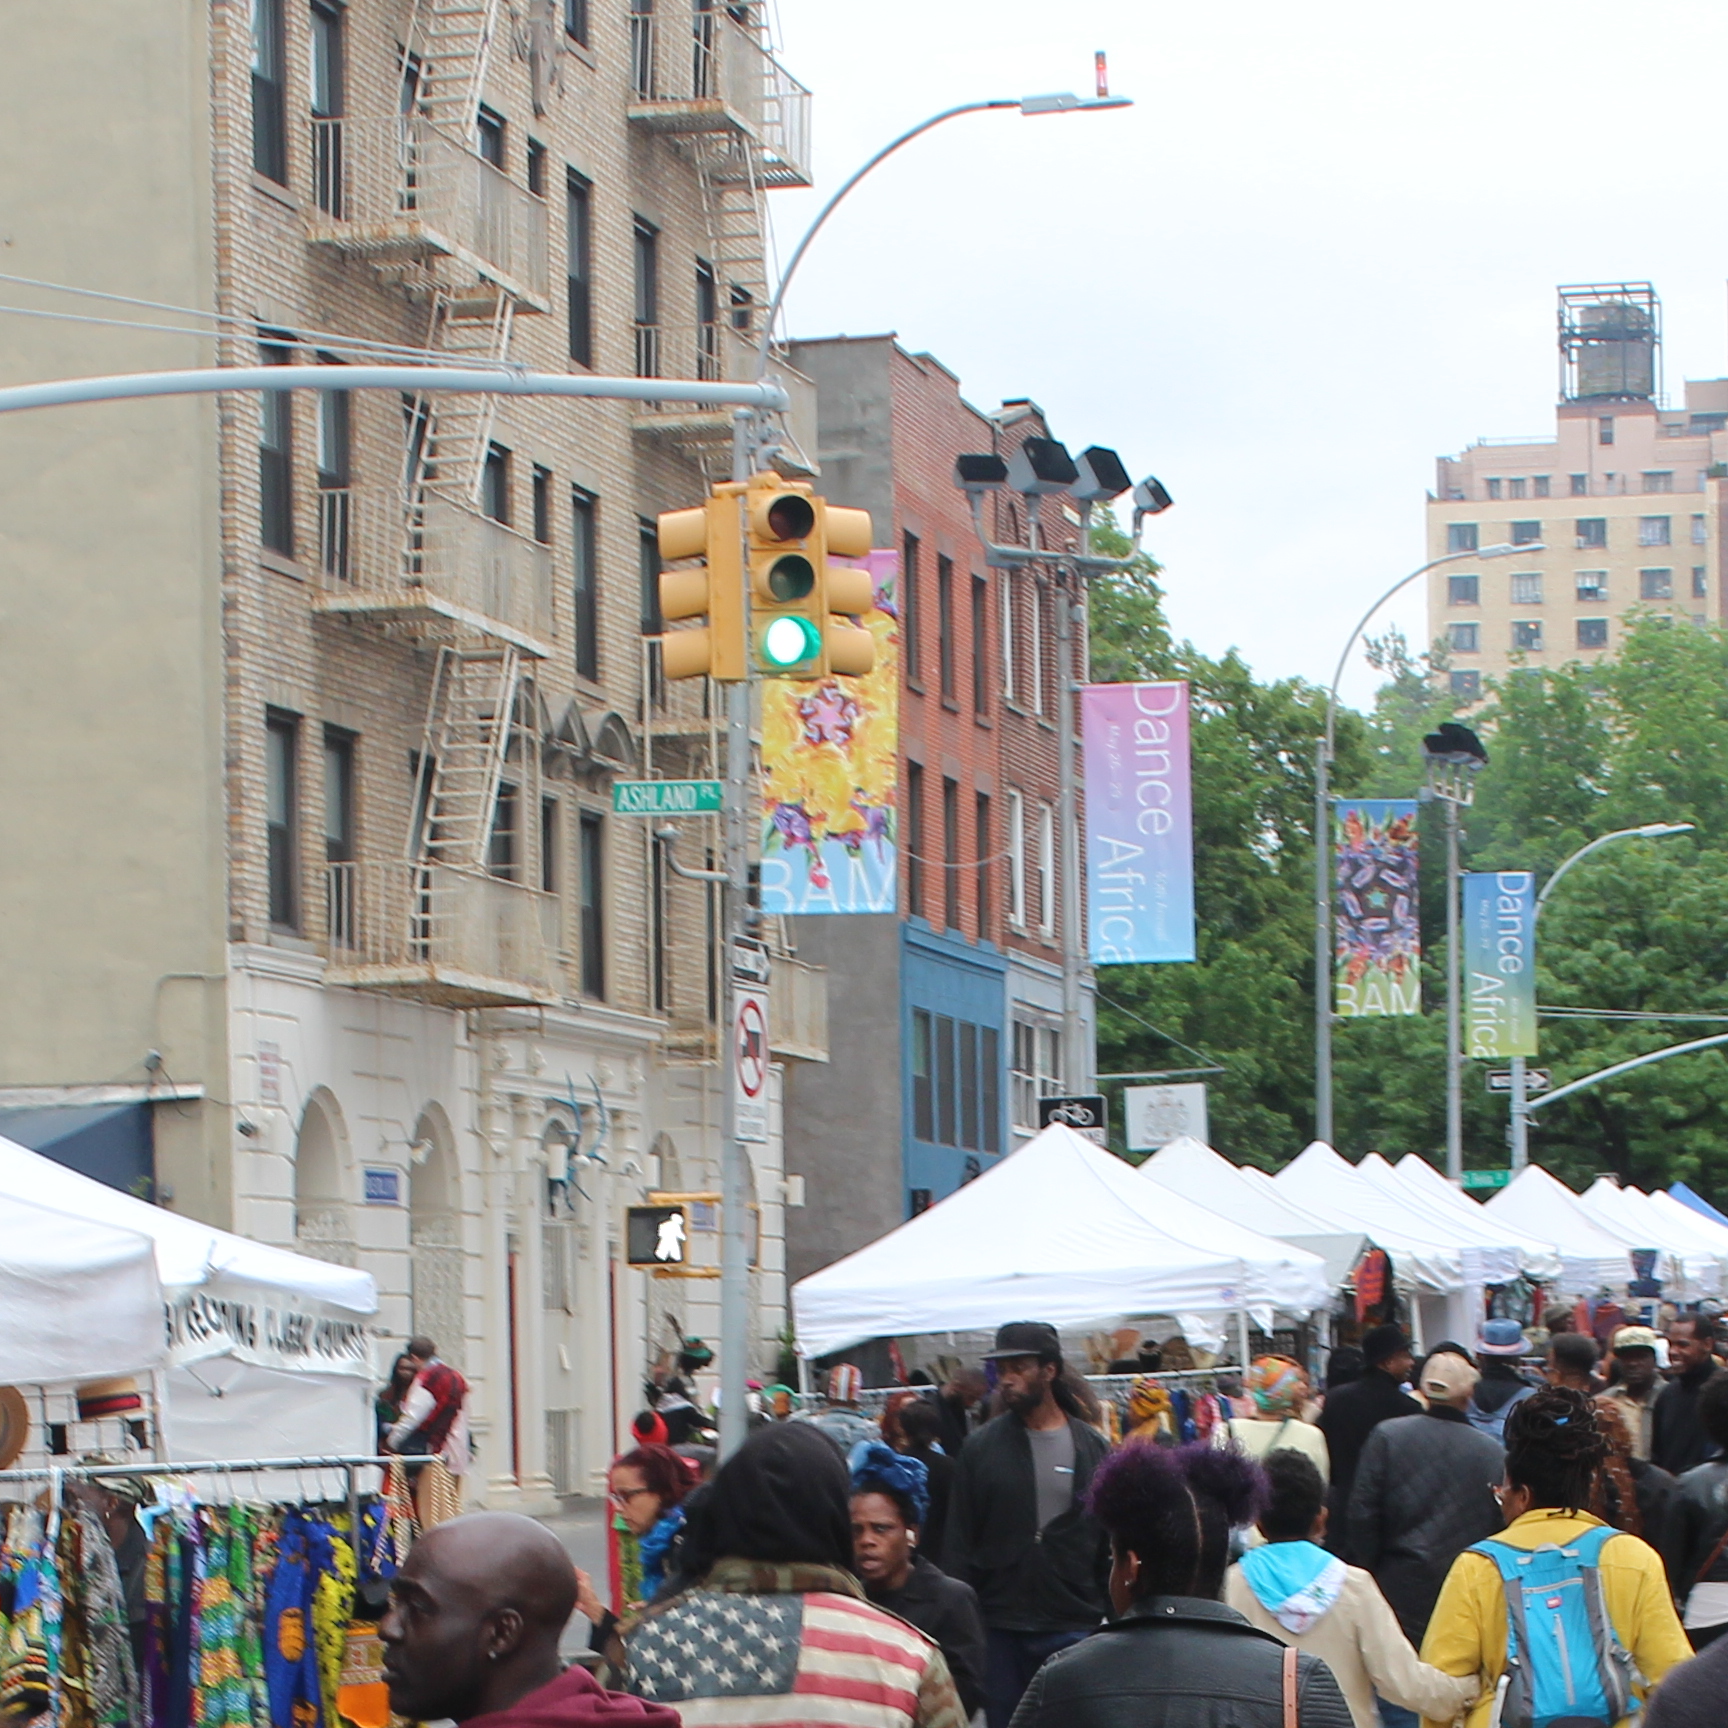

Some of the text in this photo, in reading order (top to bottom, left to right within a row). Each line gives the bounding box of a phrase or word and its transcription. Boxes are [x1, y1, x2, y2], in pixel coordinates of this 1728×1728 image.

[1134, 681, 1180, 835] Dance
[616, 784, 698, 812] ASHLAND
[760, 857, 897, 913] BAM
[1496, 871, 1532, 973] Dance
[1336, 983, 1422, 1016] BAM
